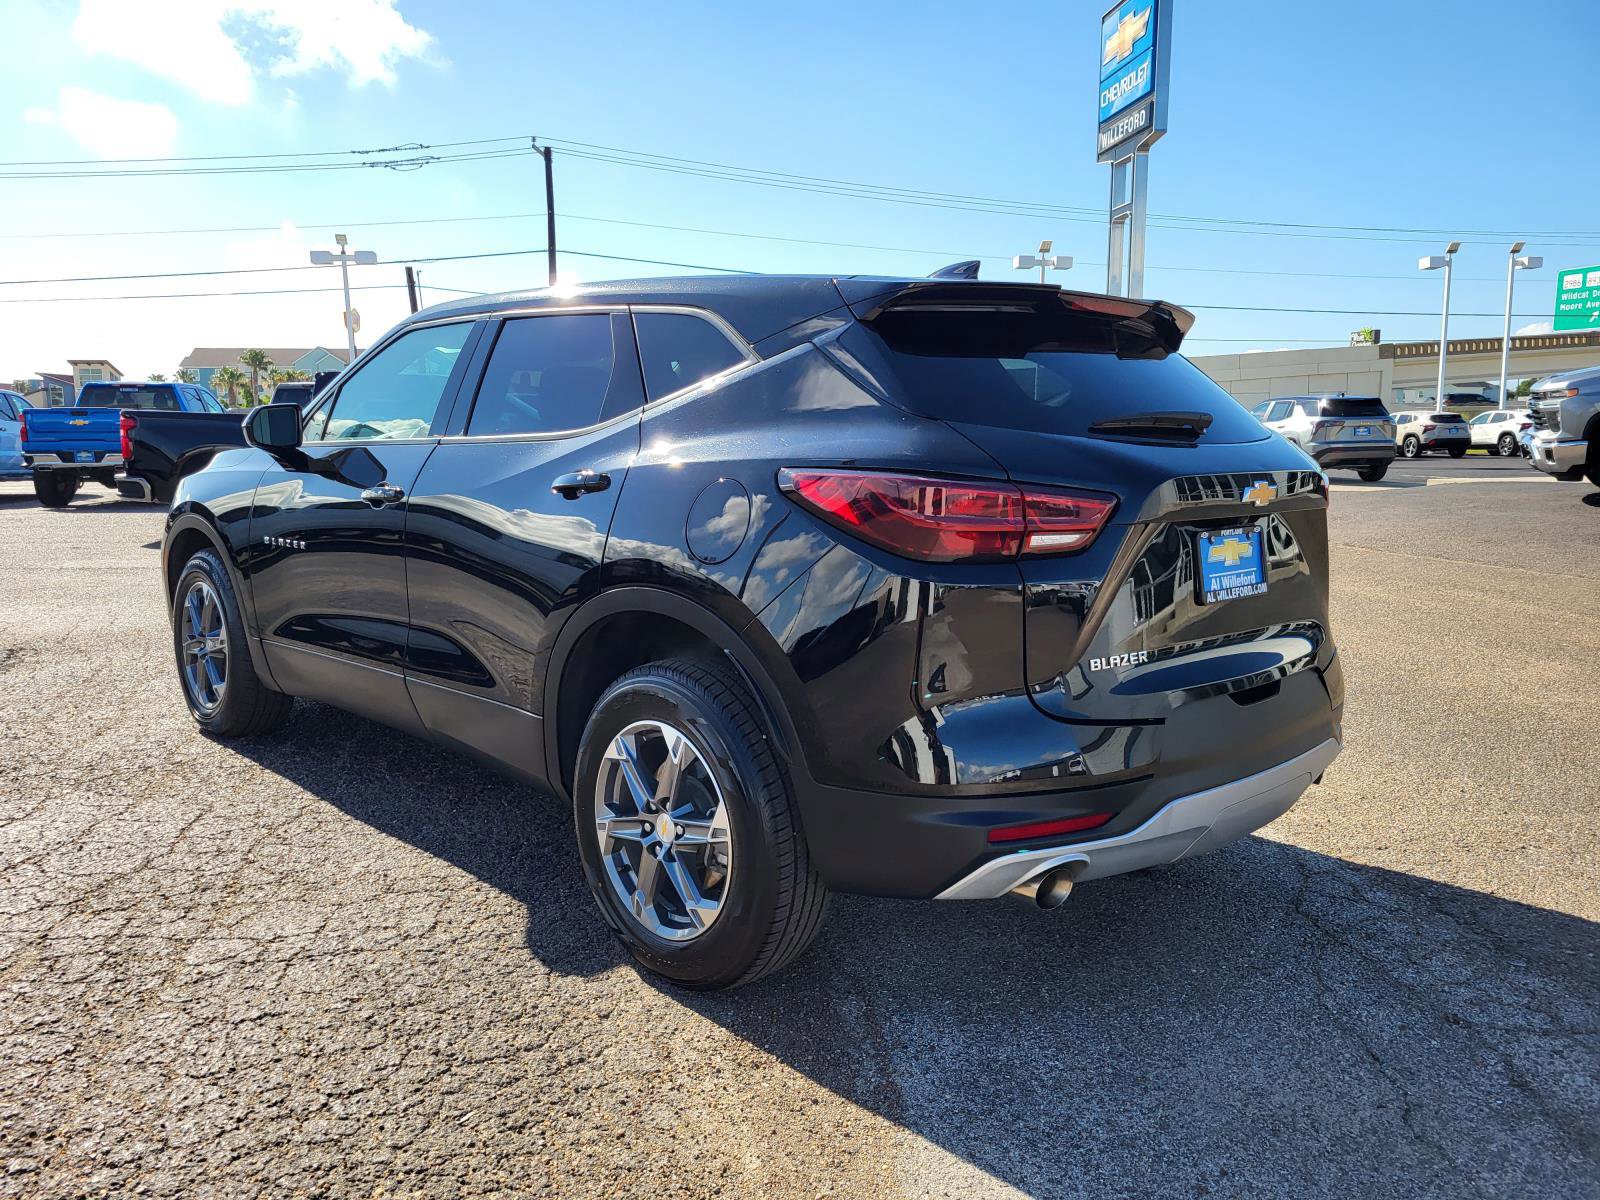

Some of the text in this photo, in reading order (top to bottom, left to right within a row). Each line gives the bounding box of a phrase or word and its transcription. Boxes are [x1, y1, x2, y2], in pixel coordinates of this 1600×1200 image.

[1101, 62, 1148, 107] CHEVROLET
[1101, 109, 1146, 148] WILLEFORD
[1561, 291, 1589, 300] Wildcat
[263, 536, 306, 550] BLAZER
[1211, 572, 1256, 591] Al Willeford
[1090, 650, 1149, 671] BLAZER
